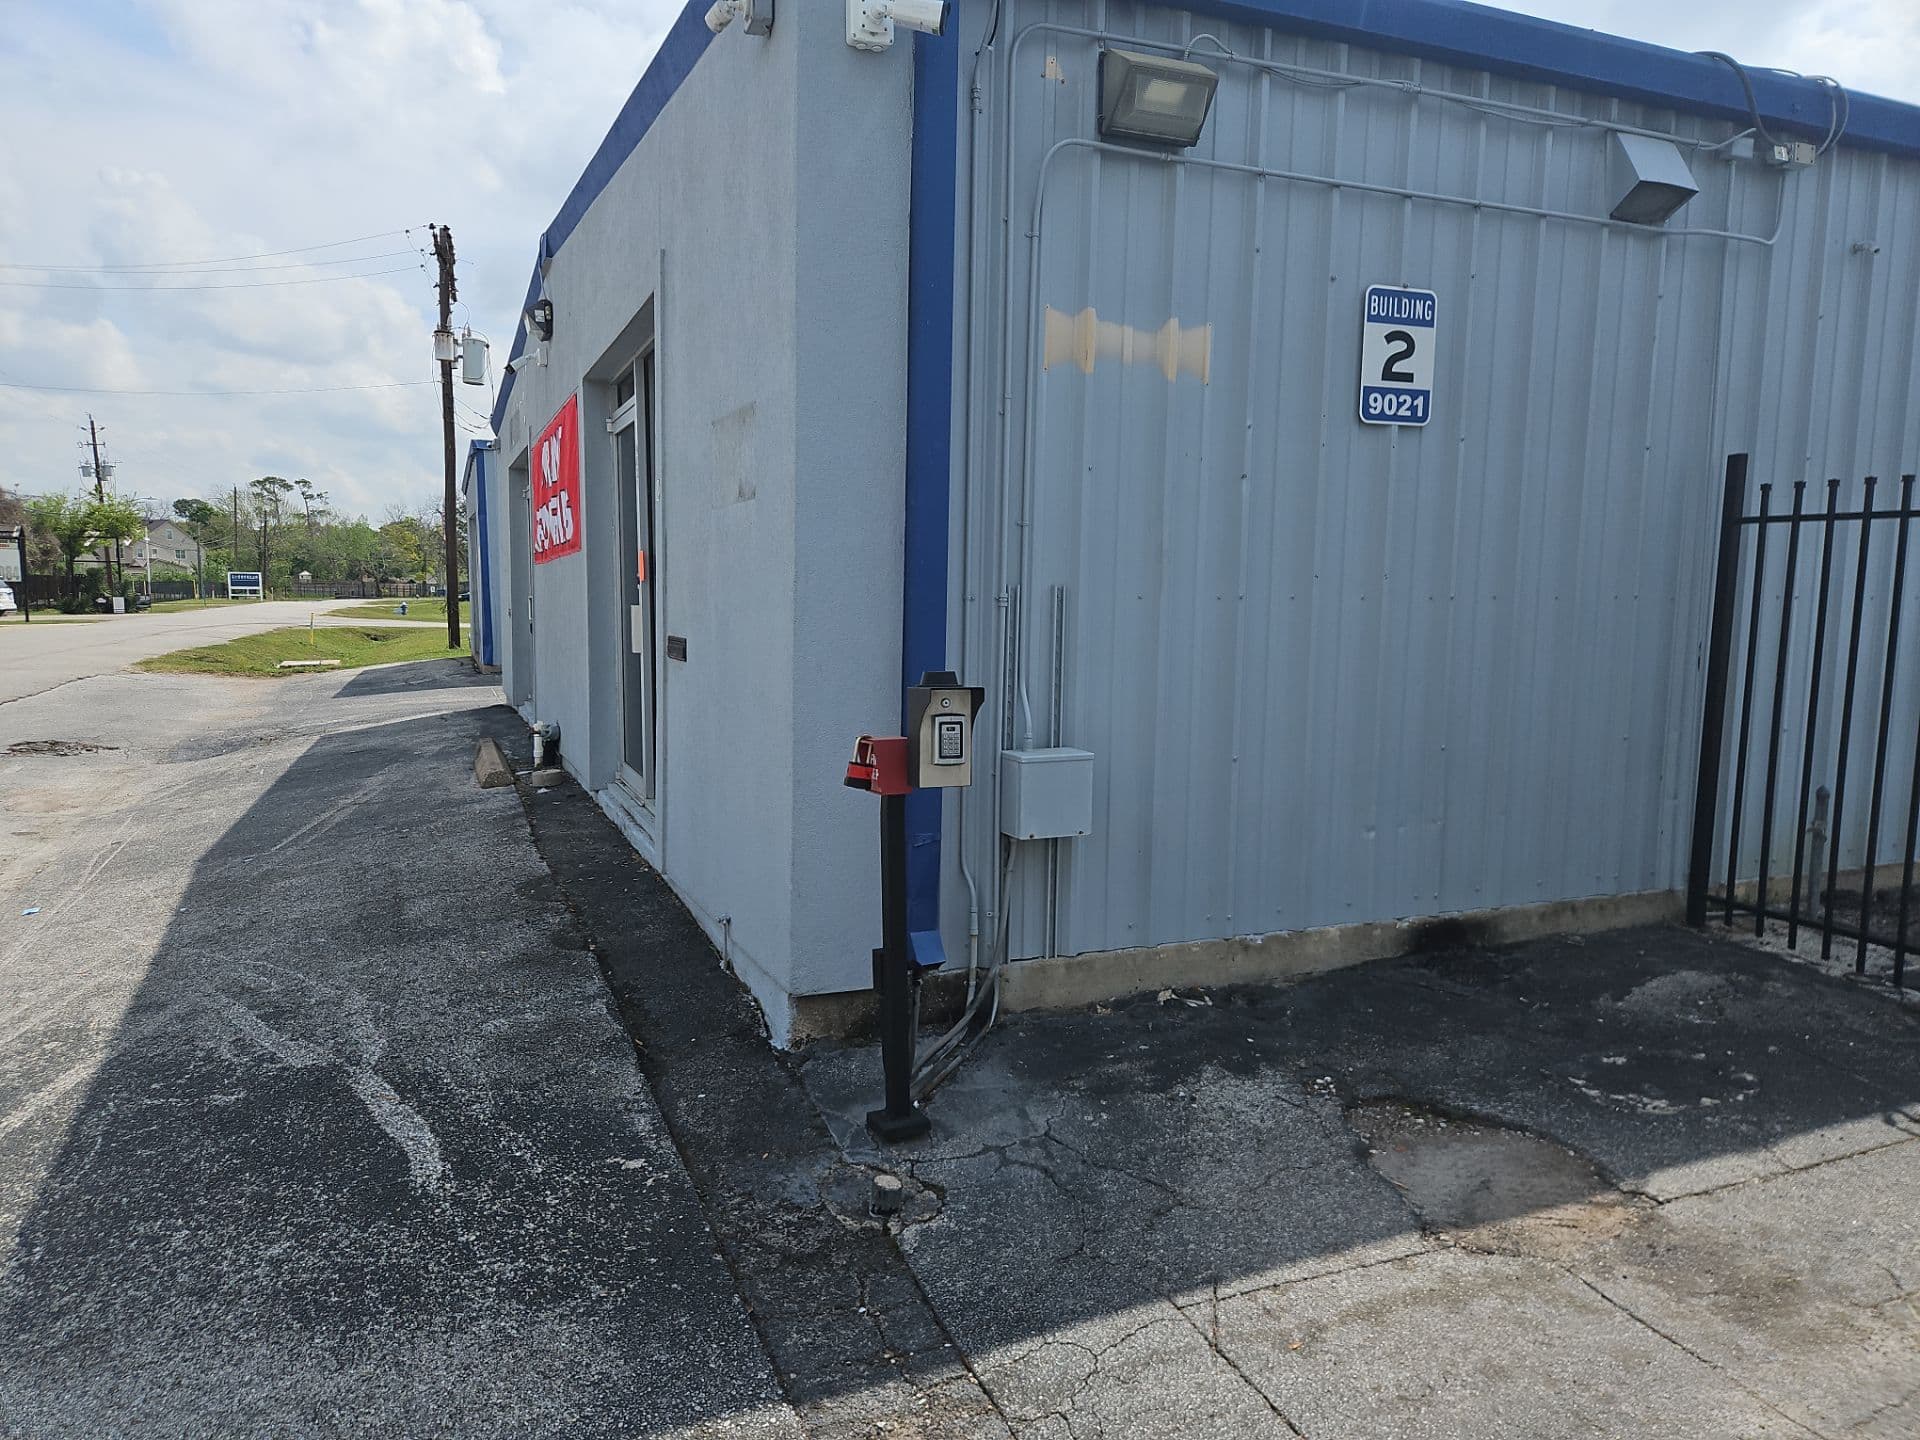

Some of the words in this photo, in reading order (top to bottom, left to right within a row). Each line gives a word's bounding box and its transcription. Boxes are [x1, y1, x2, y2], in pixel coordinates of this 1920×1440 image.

[1370, 295, 1432, 321] BUILDING
[1381, 330, 1416, 384] 2
[1368, 392, 1424, 417] 9021
